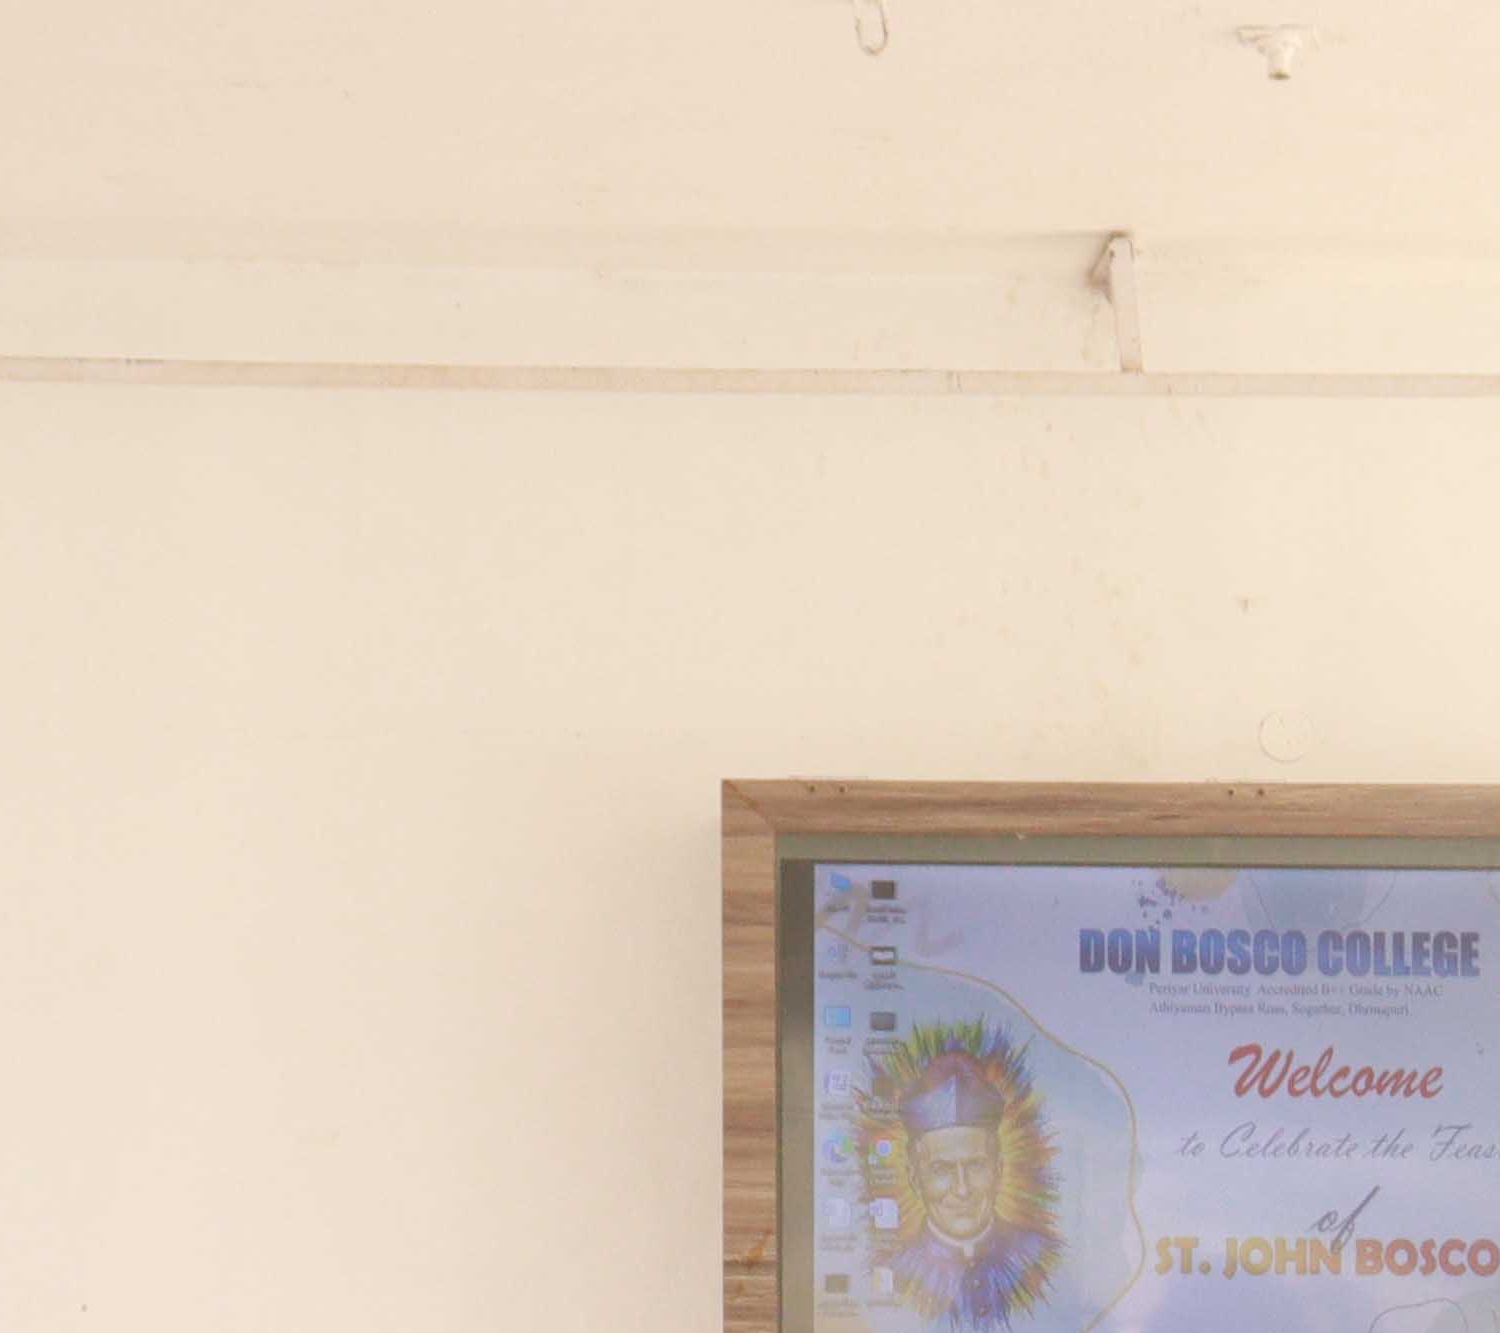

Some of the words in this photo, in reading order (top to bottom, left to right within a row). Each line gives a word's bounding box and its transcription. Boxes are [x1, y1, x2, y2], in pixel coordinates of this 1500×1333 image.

[1079, 928, 1161, 975] DON
[1170, 929, 1308, 976] BOSCO
[1317, 930, 1481, 978] COLLEGE
[1193, 982, 1251, 999] University
[1404, 984, 1444, 998] NAAC
[1228, 1042, 1444, 1099] Welcome
[1177, 1130, 1206, 1158] to
[1219, 1121, 1357, 1159] Celebrate
[1361, 1128, 1415, 1159] the
[1309, 1184, 1381, 1252] of
[1154, 1236, 1212, 1276] ST.
[1222, 1237, 1342, 1280] JOHN
[1355, 1238, 1500, 1277] BOSCO
